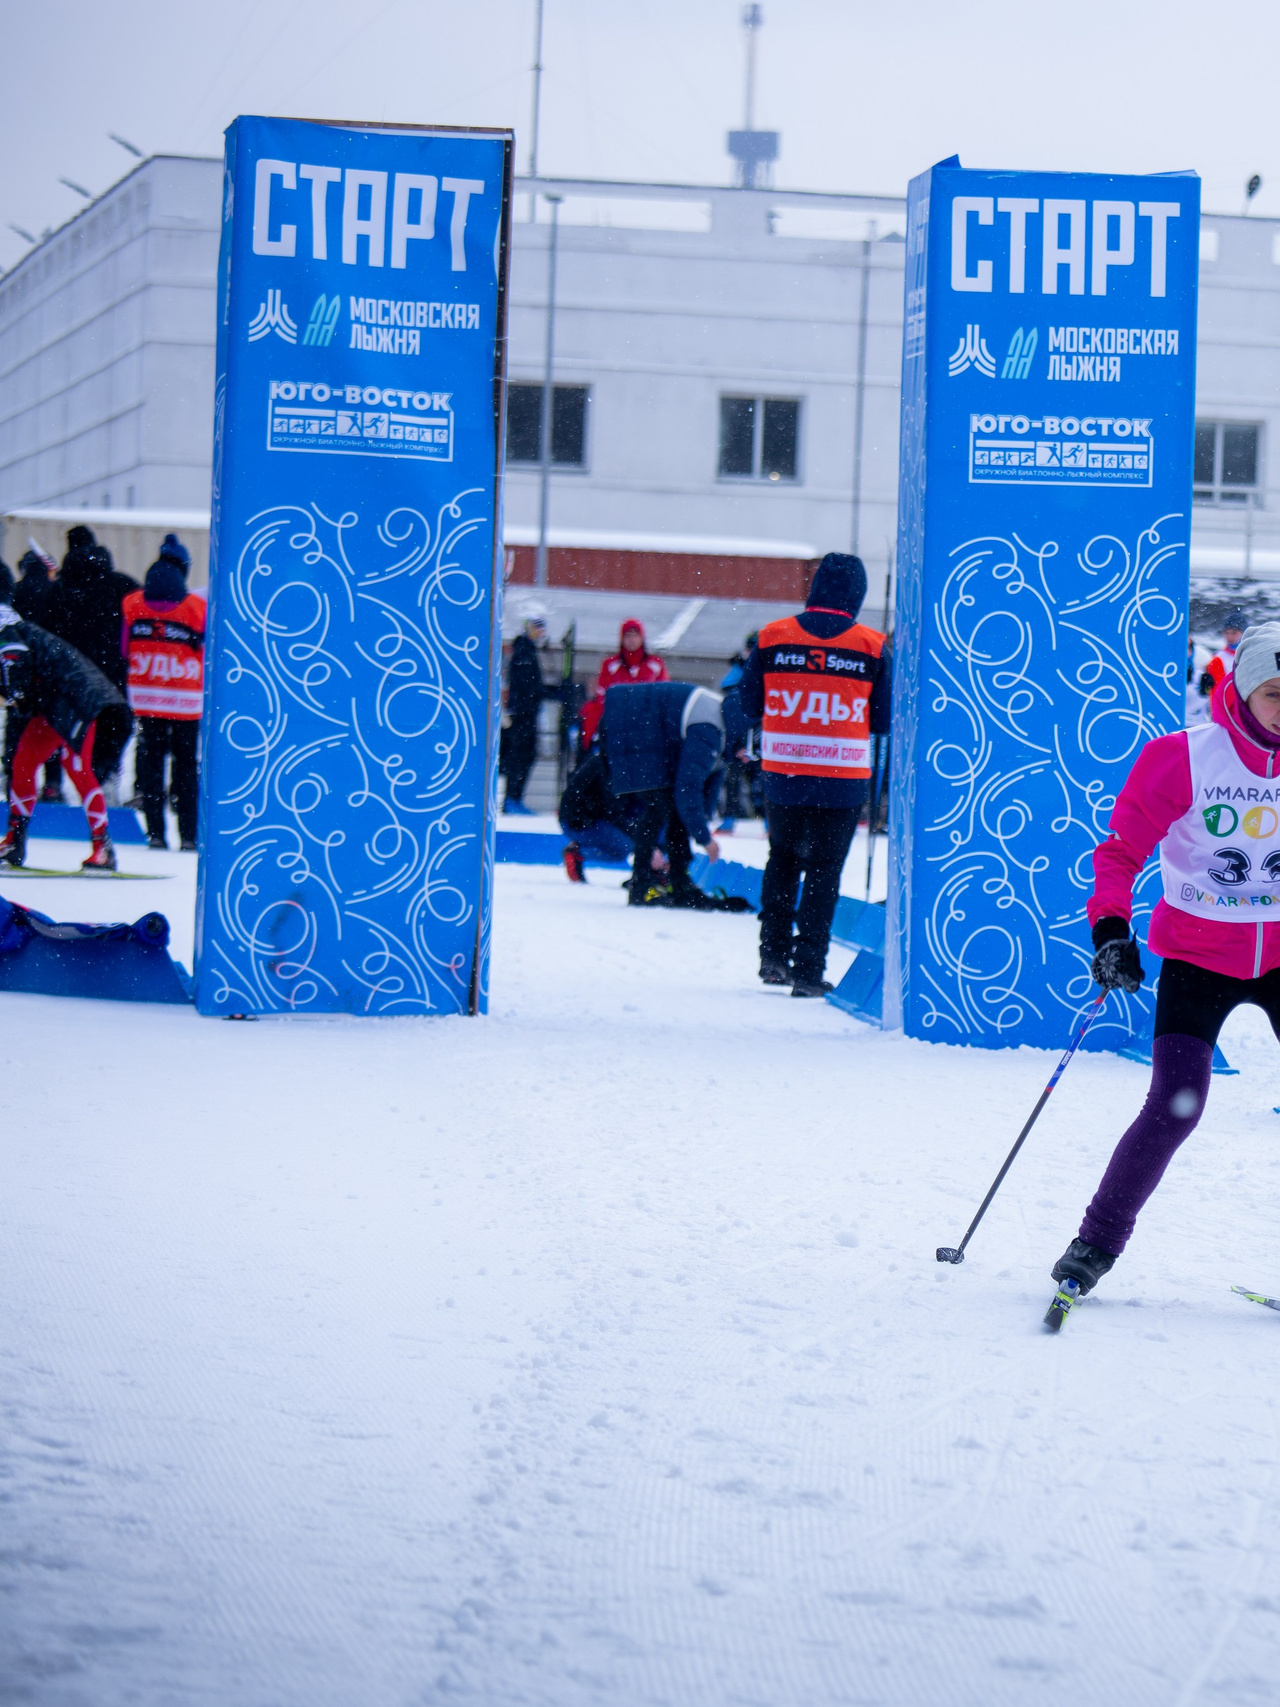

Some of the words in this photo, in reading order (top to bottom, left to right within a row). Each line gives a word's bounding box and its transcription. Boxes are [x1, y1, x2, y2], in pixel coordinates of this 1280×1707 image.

[253, 159, 485, 272] СТАРТ
[951, 196, 1181, 298] СТАРТ
[350, 296, 480, 330] МОСКОВСКАЯ
[350, 323, 421, 356] ЛЫЖНЯ
[1048, 326, 1179, 356] МОСКОВСКАЯ
[1047, 354, 1121, 383] ЛЫЖНЯ
[270, 381, 453, 411] ЮГО-ВОСТОК
[273, 436, 317, 445] ОКРУЖНОЙ
[971, 414, 1153, 438] ЮГО-ВОСТОК
[974, 468, 1017, 477] ОКРУЖНОЙ
[1103, 472, 1144, 480] КОМПЛЕКС
[774, 653, 806, 666] Arta
[827, 655, 866, 673] Sport
[764, 689, 868, 726] СУДЬЯ
[772, 742, 838, 760] МОСКОВСКИЙ
[841, 745, 866, 762] СПОРТ
